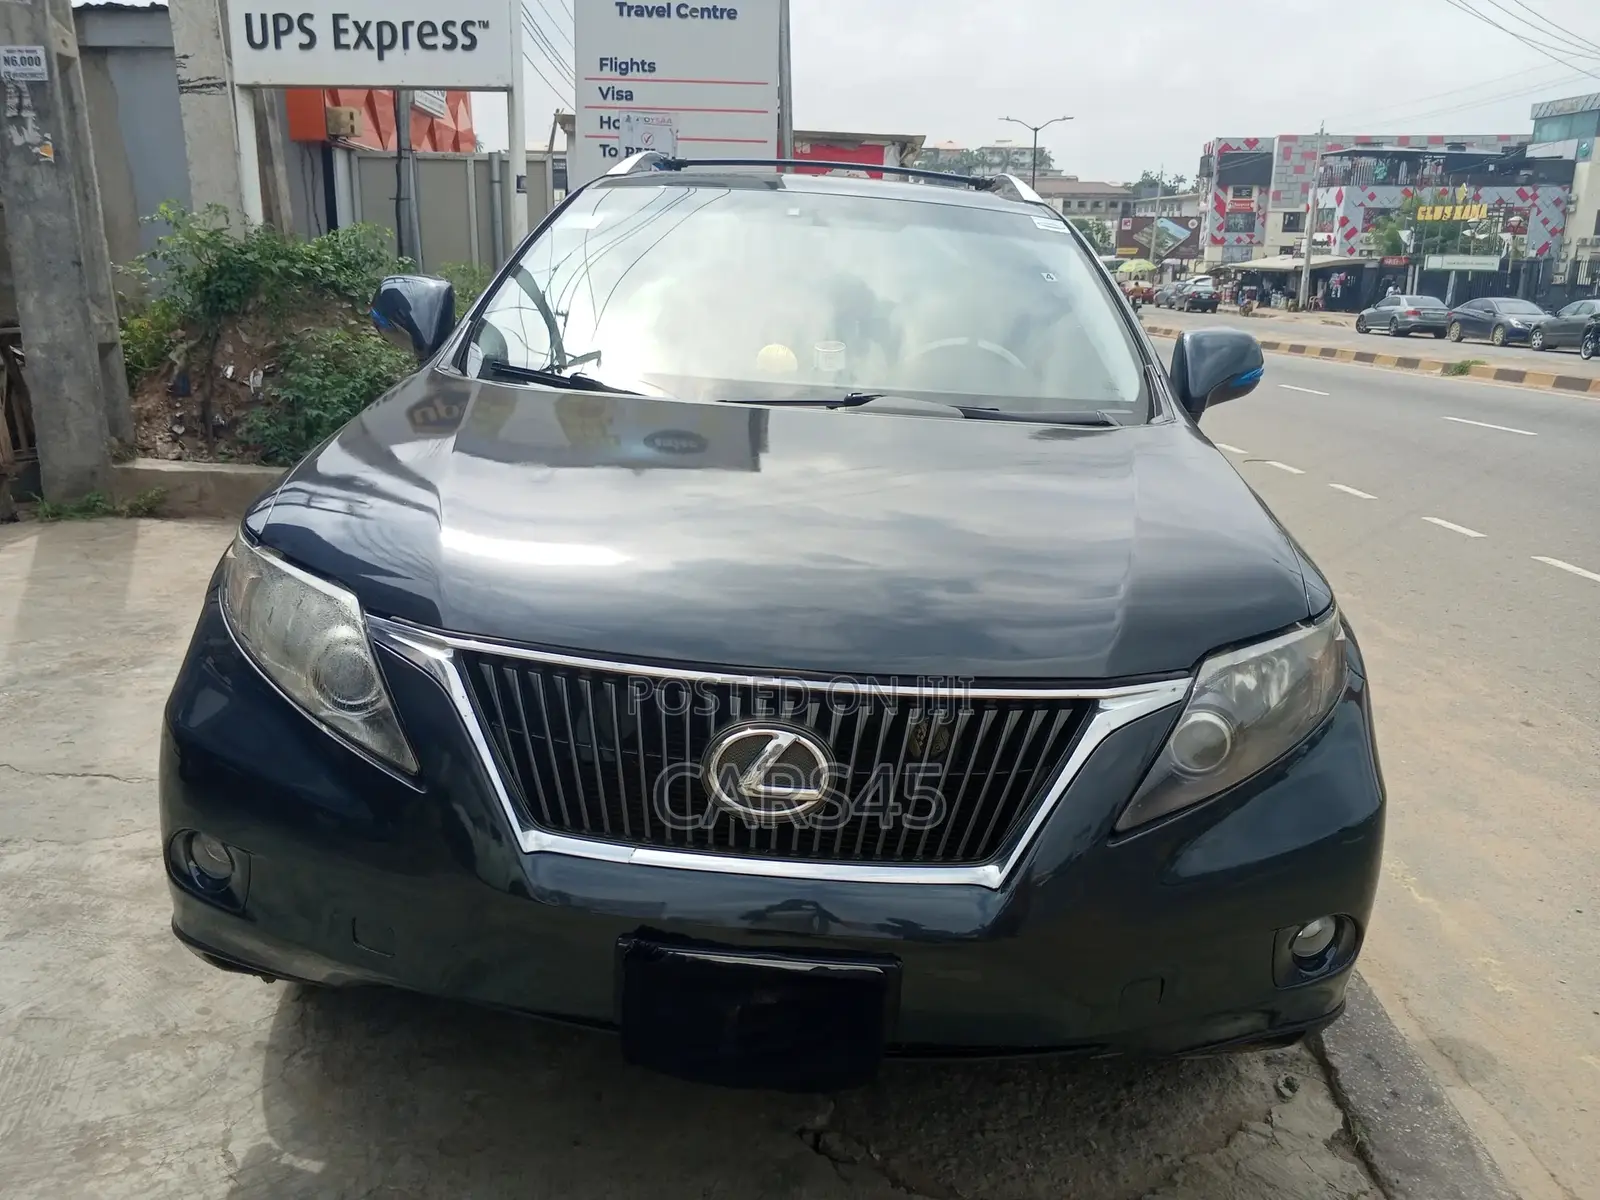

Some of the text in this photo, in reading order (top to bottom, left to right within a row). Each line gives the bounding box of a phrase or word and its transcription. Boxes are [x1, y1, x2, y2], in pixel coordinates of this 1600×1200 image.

[615, 1, 738, 20] Travel Centre
[244, 12, 317, 51] UPS
[599, 57, 656, 76] Flights
[598, 86, 634, 101] Visa
[599, 116, 620, 130] Ho
[599, 144, 619, 158] To
